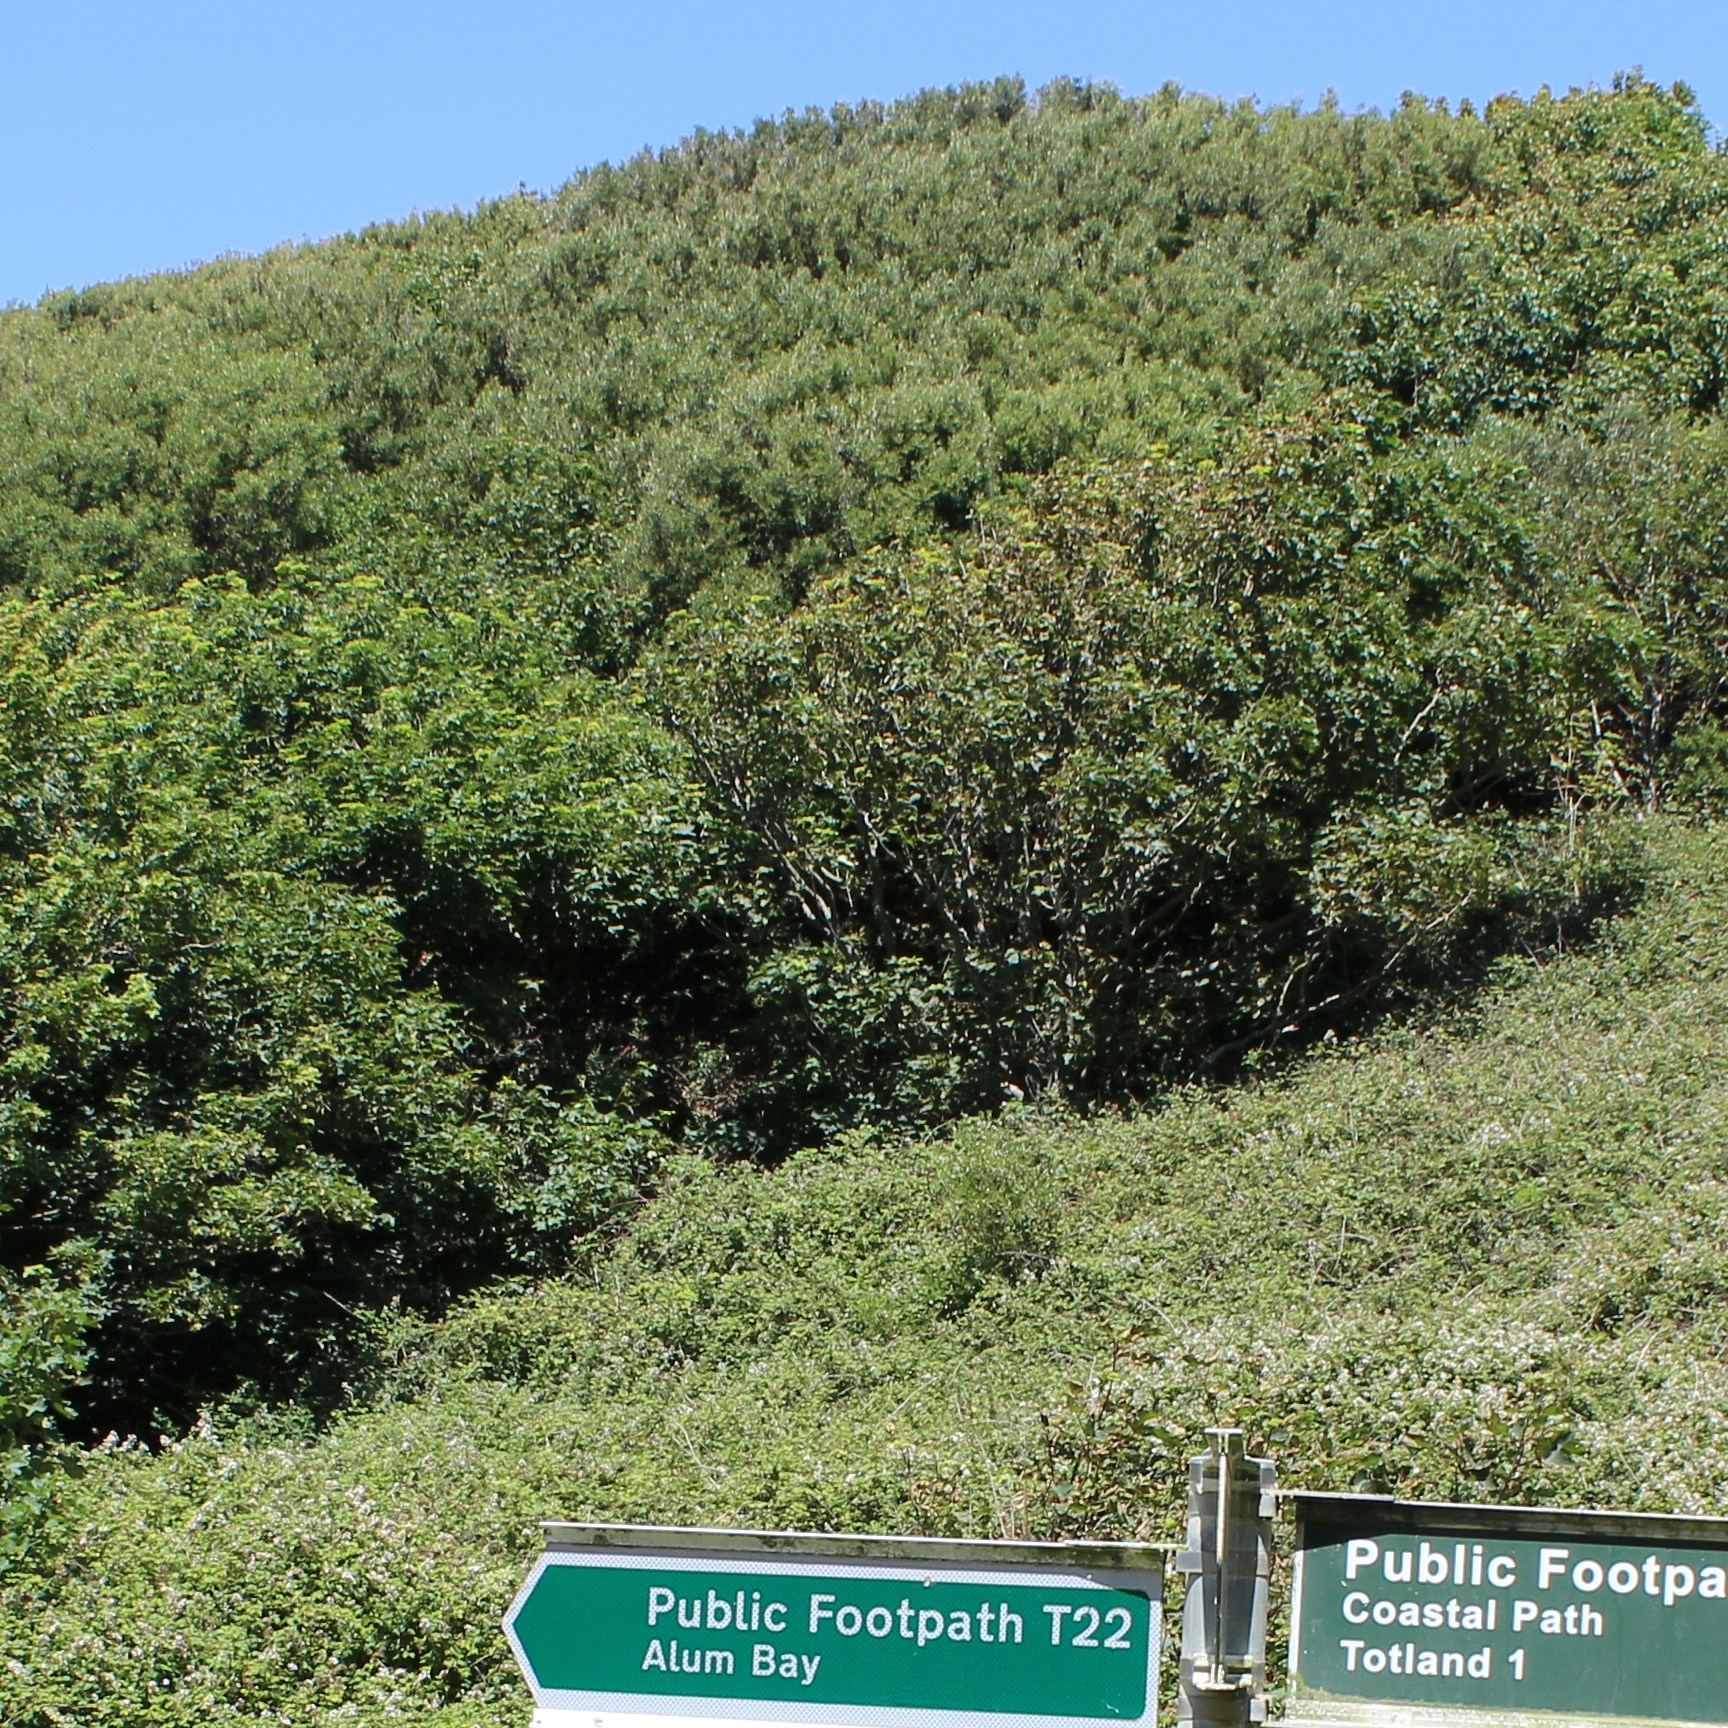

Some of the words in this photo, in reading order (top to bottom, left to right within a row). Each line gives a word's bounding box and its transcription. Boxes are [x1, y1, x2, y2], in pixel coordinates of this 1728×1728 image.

[1345, 1539, 1516, 1587] Public
[647, 1587, 788, 1632] Public
[808, 1594, 1024, 1648] Footpath
[1043, 1604, 1133, 1649] T22
[1341, 1592, 1497, 1631] Coastal
[1511, 1601, 1605, 1637] Path
[641, 1639, 735, 1675] Alum
[752, 1644, 821, 1686] Bay
[1339, 1640, 1491, 1680] Totland
[1508, 1649, 1525, 1680] 1
